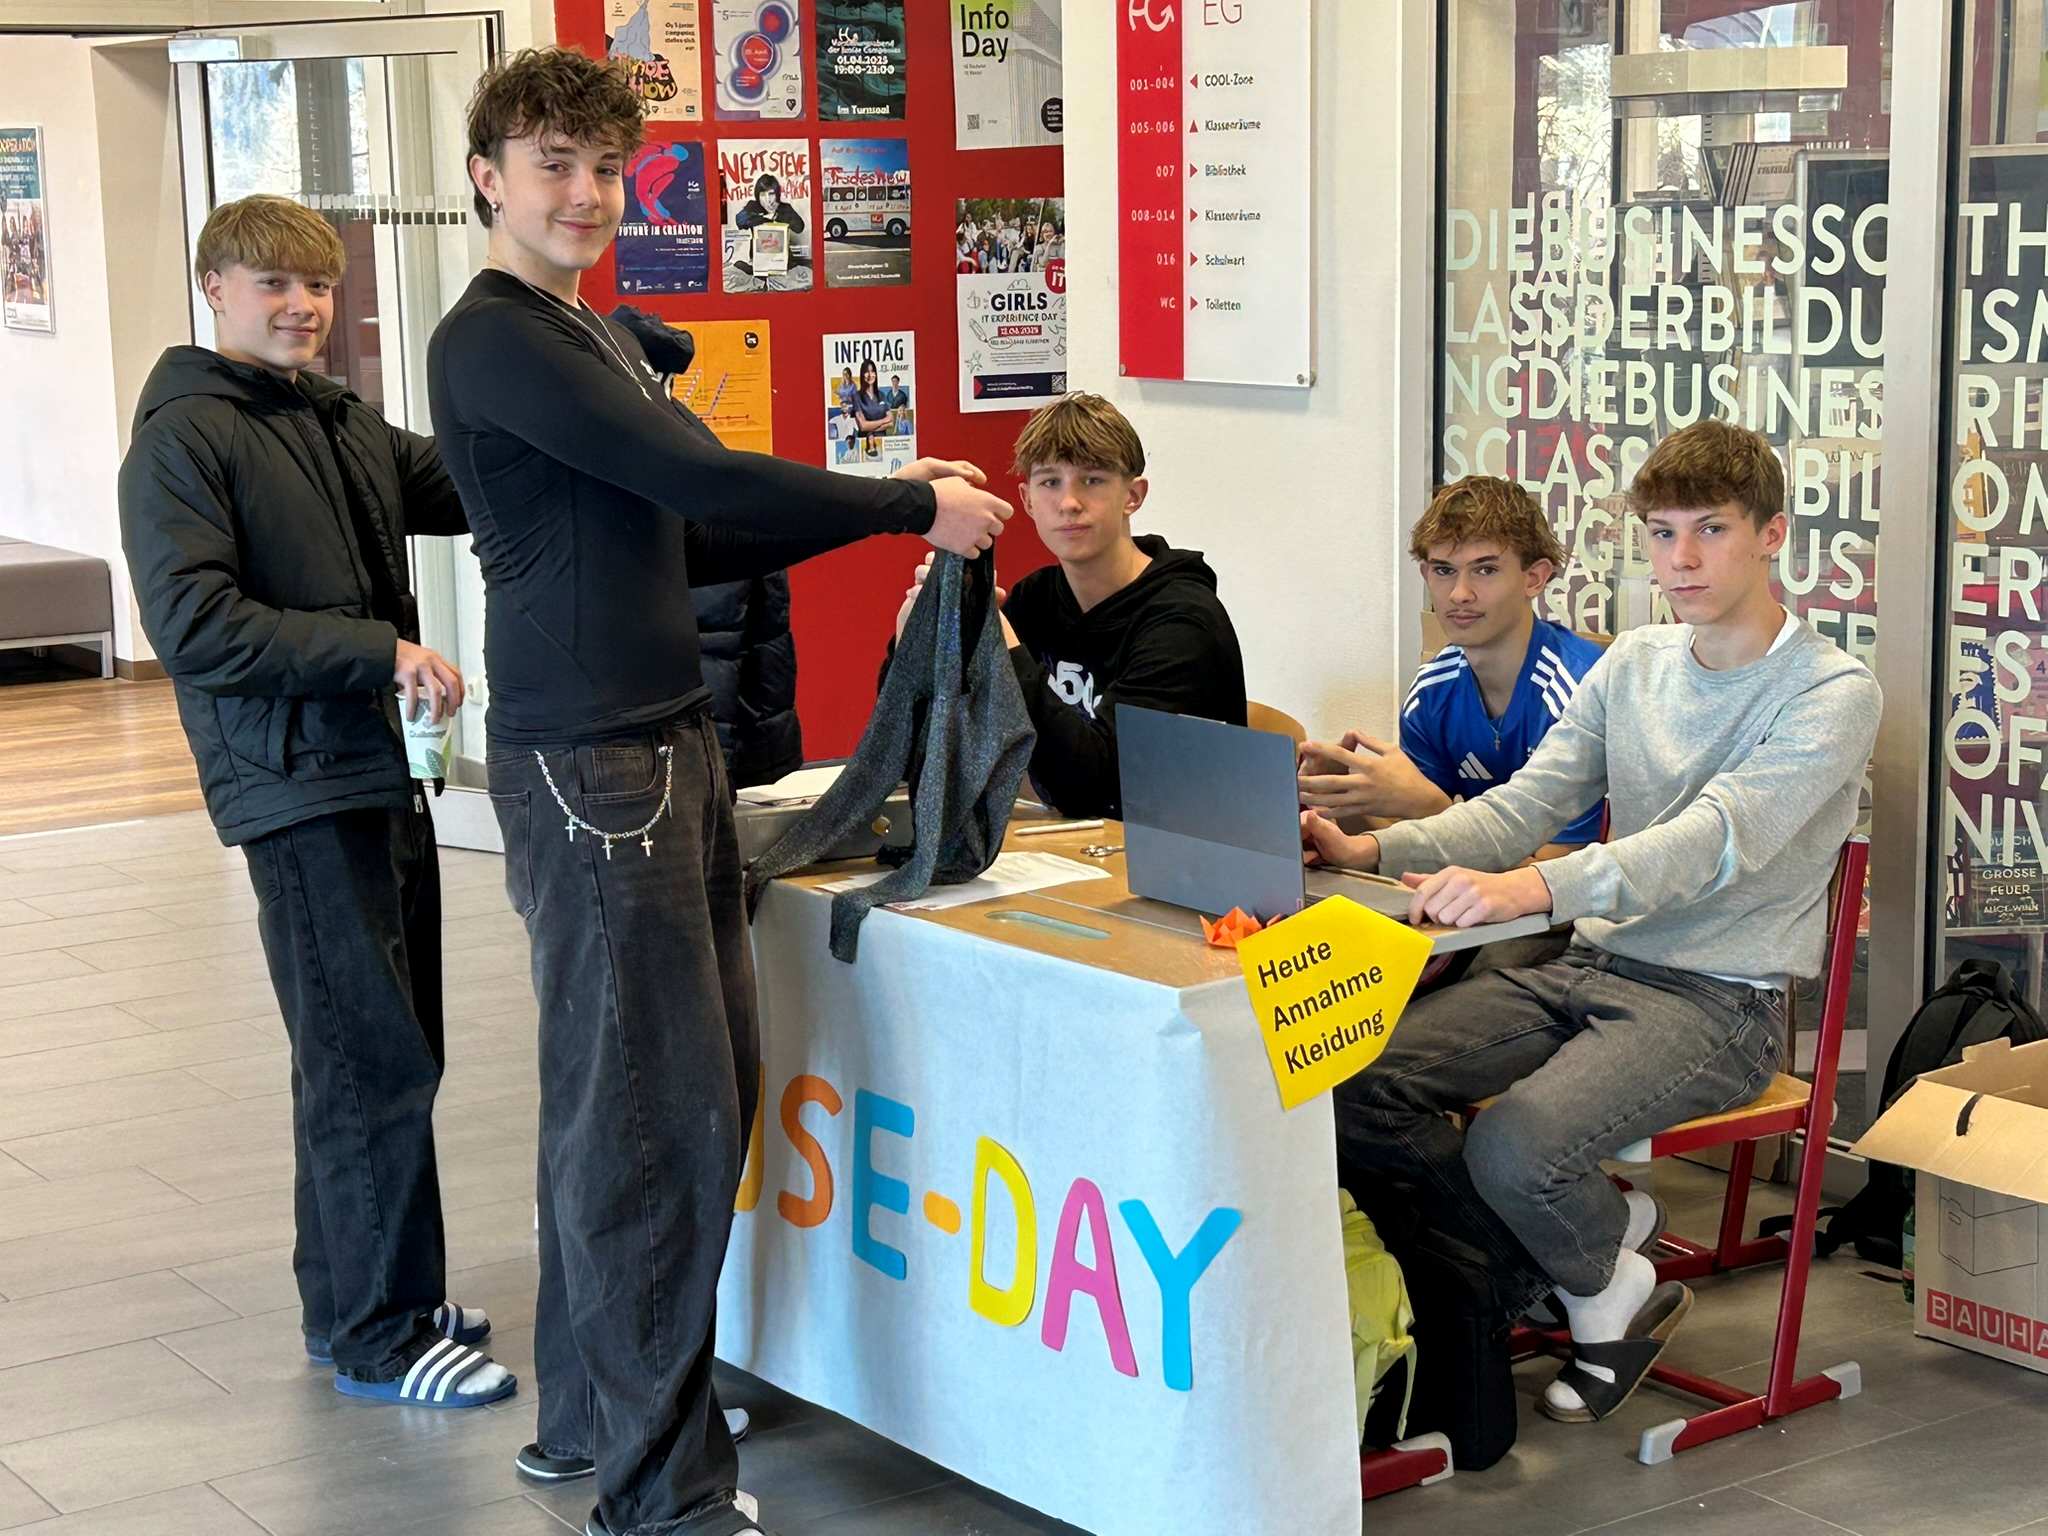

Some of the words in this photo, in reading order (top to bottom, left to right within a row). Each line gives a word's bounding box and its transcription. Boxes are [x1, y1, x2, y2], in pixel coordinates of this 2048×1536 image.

[960, 3, 1009, 30] Info
[962, 31, 1009, 63] Day
[1204, 73, 1254, 87] COOL-Zone
[1130, 120, 1175, 134] 005-006
[1204, 119, 1261, 131] Klassenräume
[720, 150, 768, 184] NEXT
[769, 151, 807, 177] STEVE
[1156, 165, 1175, 177] 007
[1204, 163, 1246, 177] Bibliothek
[1131, 209, 1176, 222] 008-014
[1204, 209, 1261, 222] Klassenräume
[618, 225, 649, 236] FUTURE
[662, 224, 704, 236] CREATION
[1156, 253, 1176, 265] 016
[1205, 254, 1245, 267] Schulwart
[1051, 271, 1065, 288] IT
[990, 292, 1048, 312] GIRLS
[1160, 297, 1176, 309] WC
[1205, 298, 1241, 312] Toiletten
[982, 314, 989, 324] IT
[991, 313, 1039, 322] EXPERIENCE
[1041, 312, 1058, 322] DAY
[834, 338, 904, 364] INFOTAG
[1945, 706, 2048, 789] OF
[1982, 868, 2037, 880] GROSSE
[1990, 884, 2031, 896] FEUER
[1258, 942, 1332, 988] Heute
[1273, 965, 1383, 1032] Annahme
[1284, 1009, 1385, 1074] Kleidung
